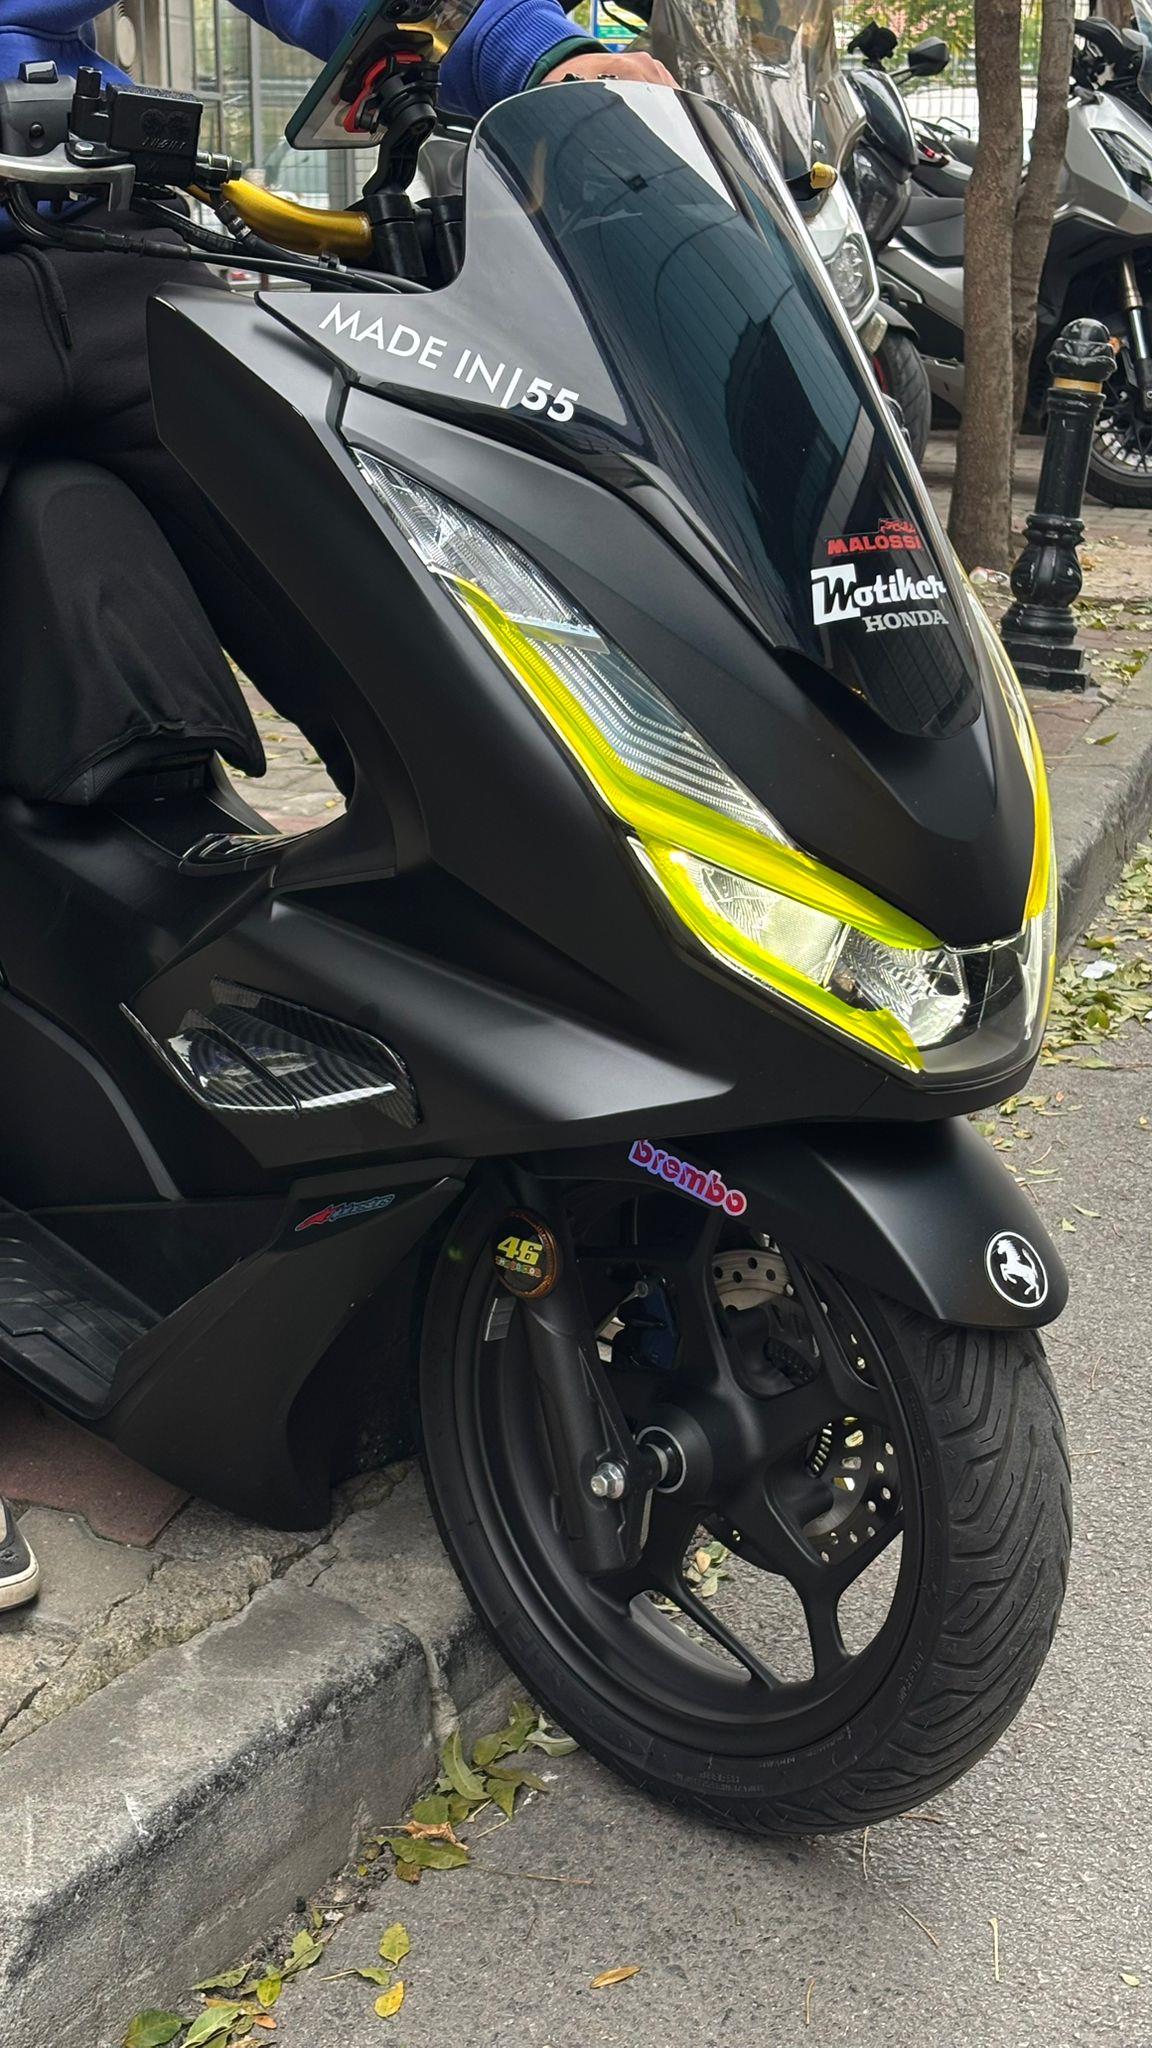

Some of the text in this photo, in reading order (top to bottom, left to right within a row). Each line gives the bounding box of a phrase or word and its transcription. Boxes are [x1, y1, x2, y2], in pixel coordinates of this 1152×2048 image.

[319, 302, 448, 370] MADE
[827, 535, 923, 555] MALOSSI
[862, 609, 949, 632] HONDA
[628, 1140, 747, 1216] brembo
[497, 1236, 543, 1265] 46
